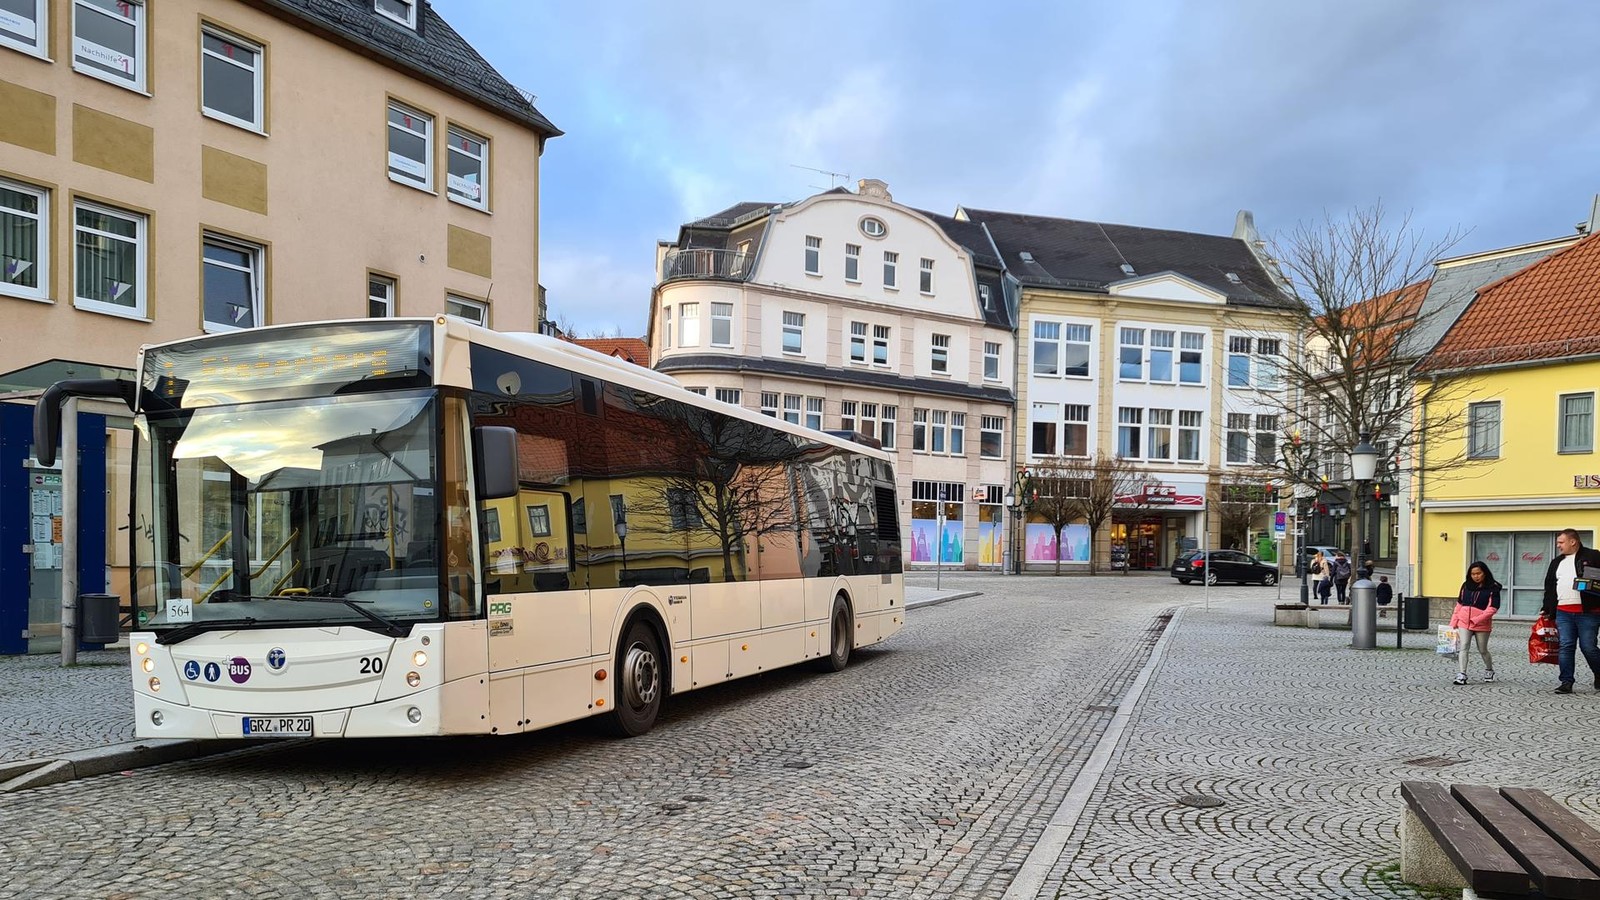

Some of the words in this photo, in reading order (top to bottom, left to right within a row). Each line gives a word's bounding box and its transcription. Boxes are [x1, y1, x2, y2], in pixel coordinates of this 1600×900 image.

[81, 45, 118, 63] Nachhilfe
[45, 475, 62, 483] PR
[171, 605, 189, 617] 564
[489, 602, 512, 614] PRG
[230, 664, 250, 675] BUS
[360, 657, 383, 673] 20
[250, 719, 272, 732] GRZ
[279, 718, 294, 732] PR
[296, 718, 311, 731] 20
